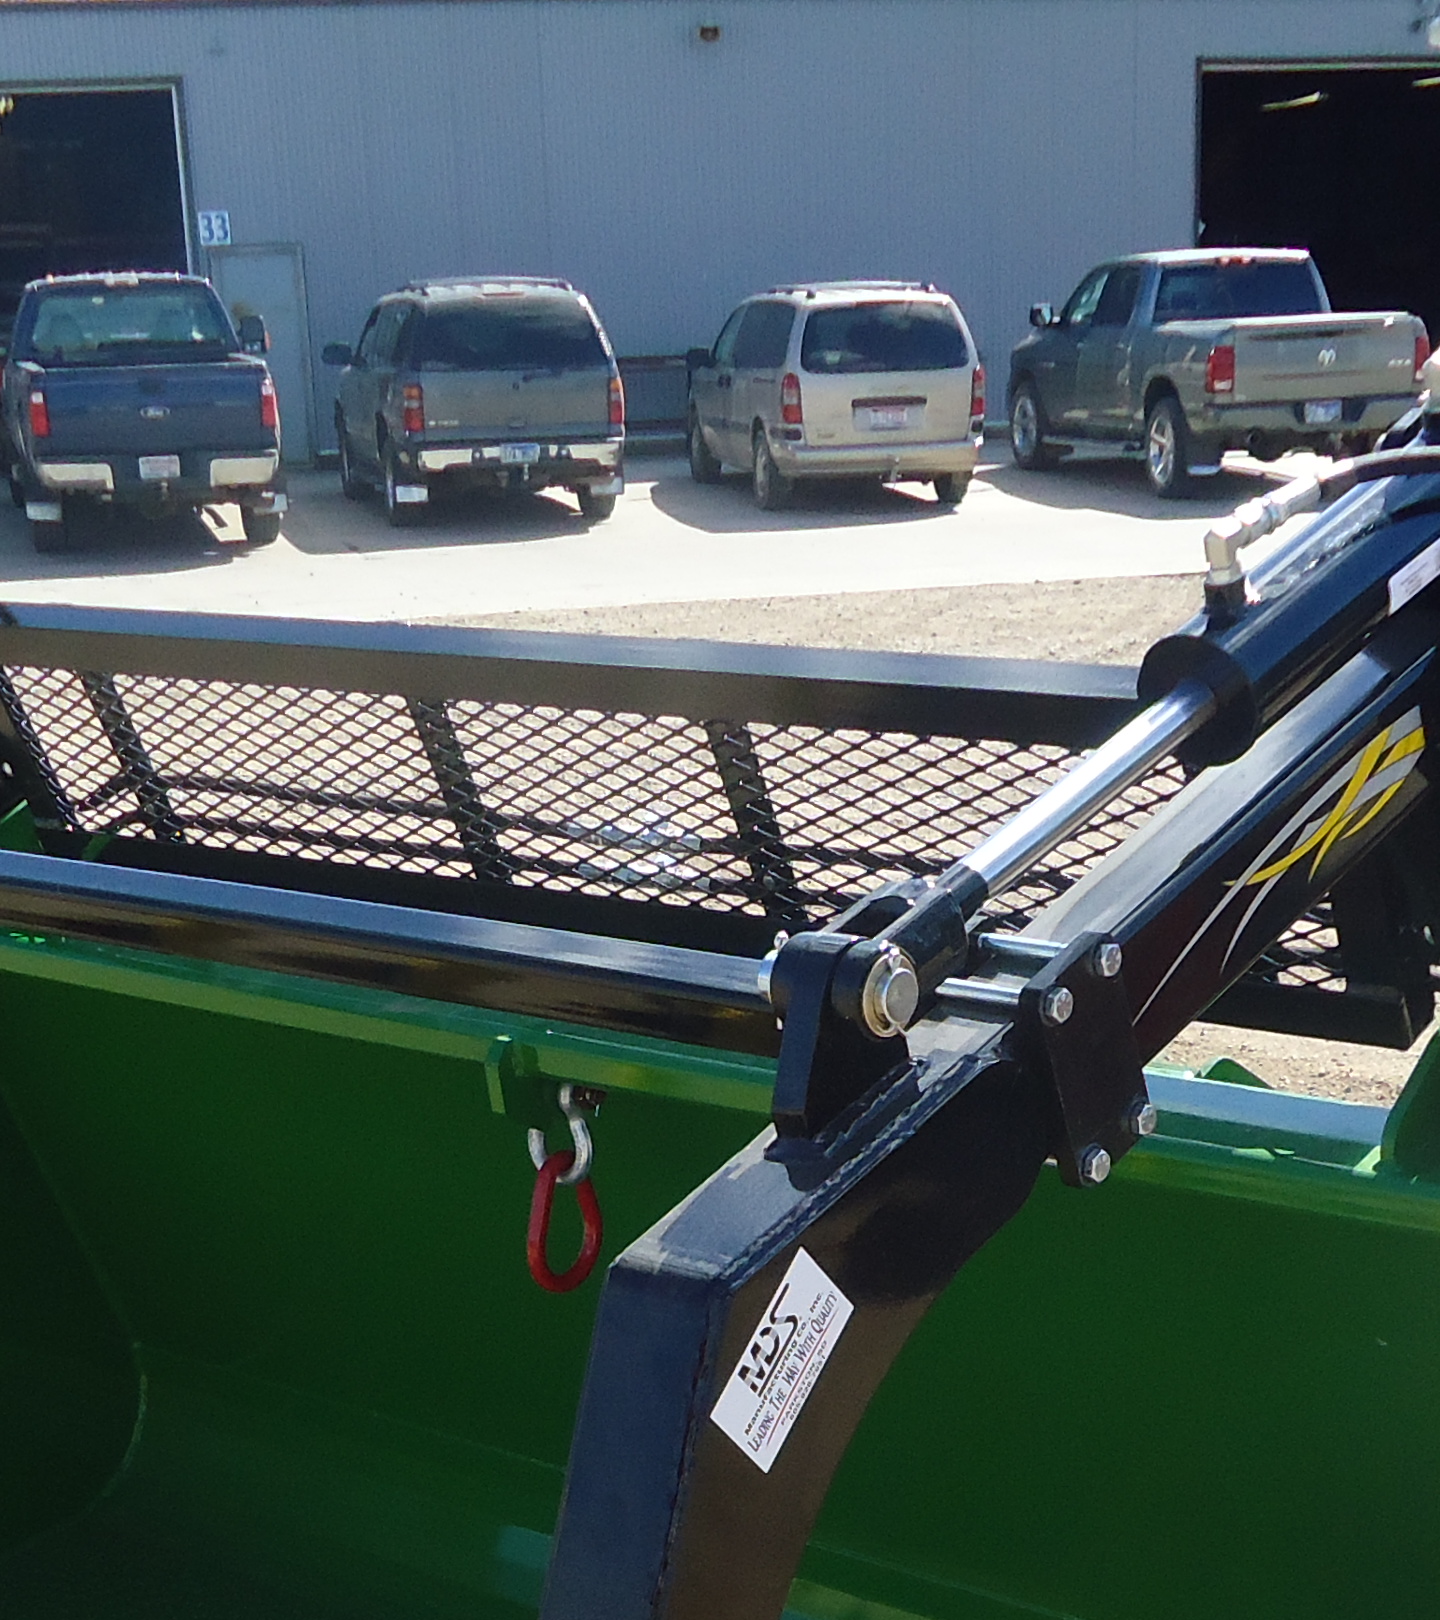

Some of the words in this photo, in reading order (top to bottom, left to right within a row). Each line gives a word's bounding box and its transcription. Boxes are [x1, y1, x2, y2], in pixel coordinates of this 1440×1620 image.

[201, 213, 229, 242] 33
[737, 1282, 799, 1398] MDS
[744, 1339, 798, 1436] Manufacturing
